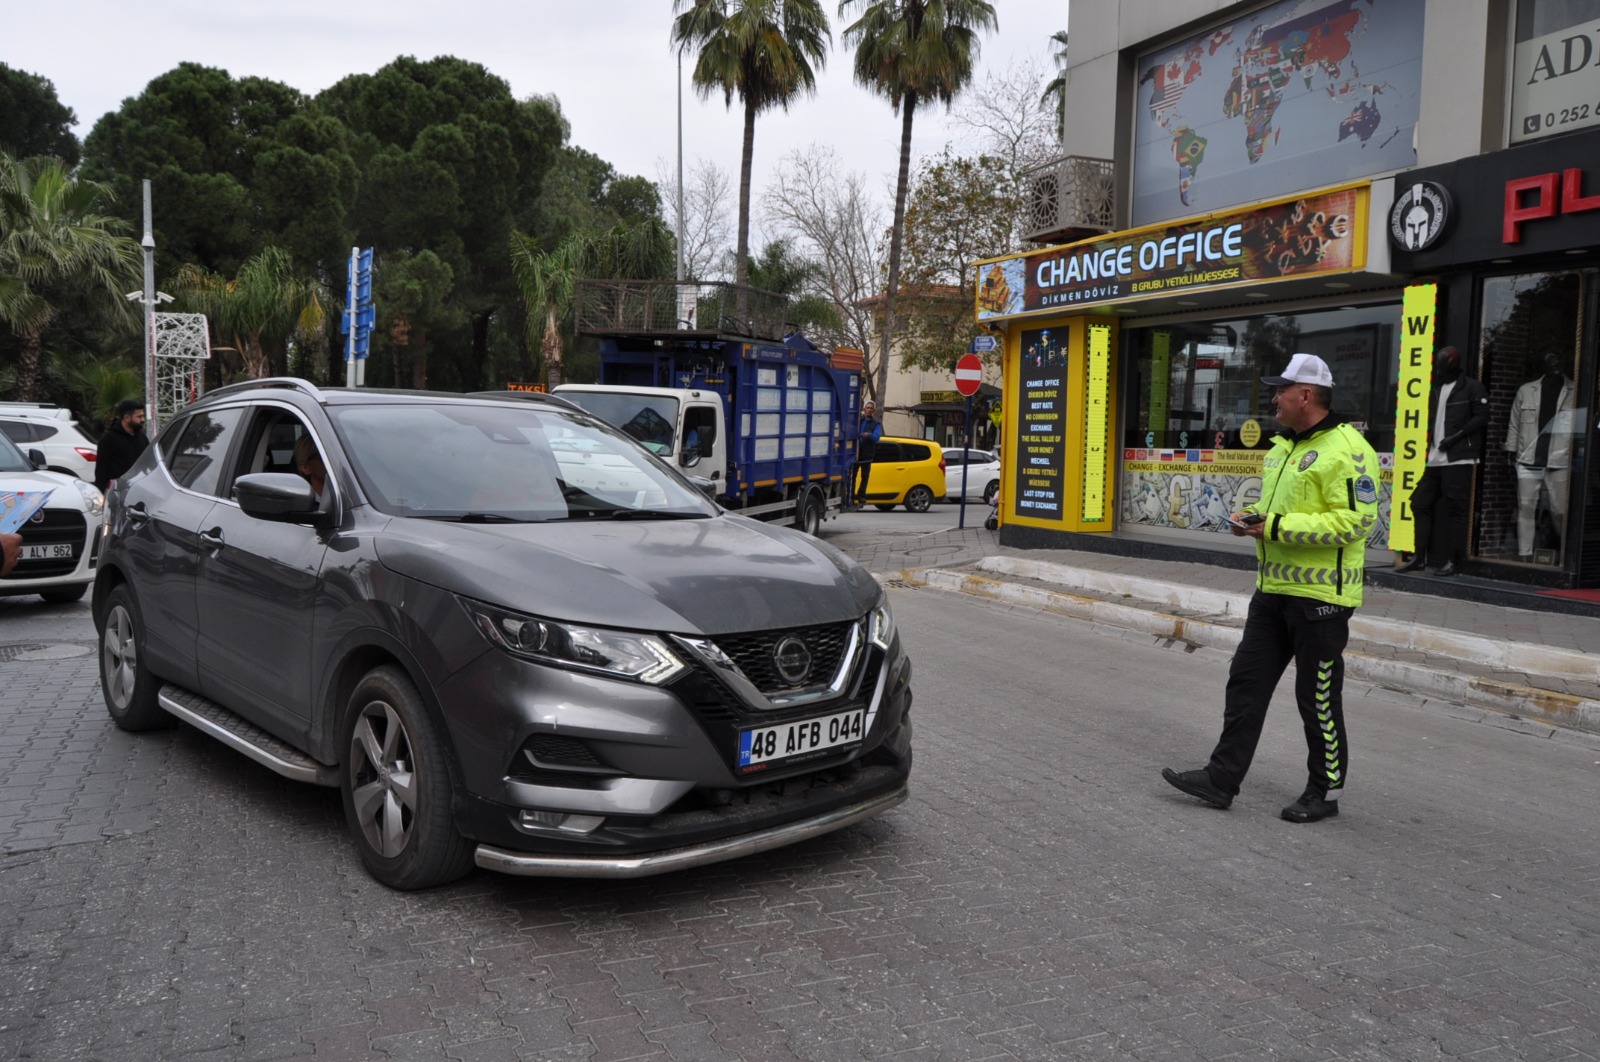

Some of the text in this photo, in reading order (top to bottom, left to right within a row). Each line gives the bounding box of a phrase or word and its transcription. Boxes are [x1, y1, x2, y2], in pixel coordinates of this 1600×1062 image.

[1545, 112, 1555, 127] 0
[1559, 103, 1590, 125] 252
[1036, 223, 1242, 288] CHANGE OFFICE
[1131, 267, 1240, 292] B GRUBU YETKİLİ MÜESSESE
[1042, 284, 1119, 305] DİKMEN DÖVİZ
[1400, 315, 1429, 522] WECHSEL
[1217, 452, 1225, 460] The
[1226, 452, 1236, 460] Real
[1237, 452, 1249, 461] Value
[1250, 453, 1256, 461] of
[1128, 463, 1257, 474] CHANGE EXCHANGE NO COMMISSION
[1046, 491, 1055, 499] FOR
[1020, 500, 1058, 510] MONEY EXCHANGE
[30, 546, 48, 558] ALY
[54, 545, 71, 557] 962
[752, 712, 861, 759] 48 AFB 044
[741, 751, 750, 760] TR
